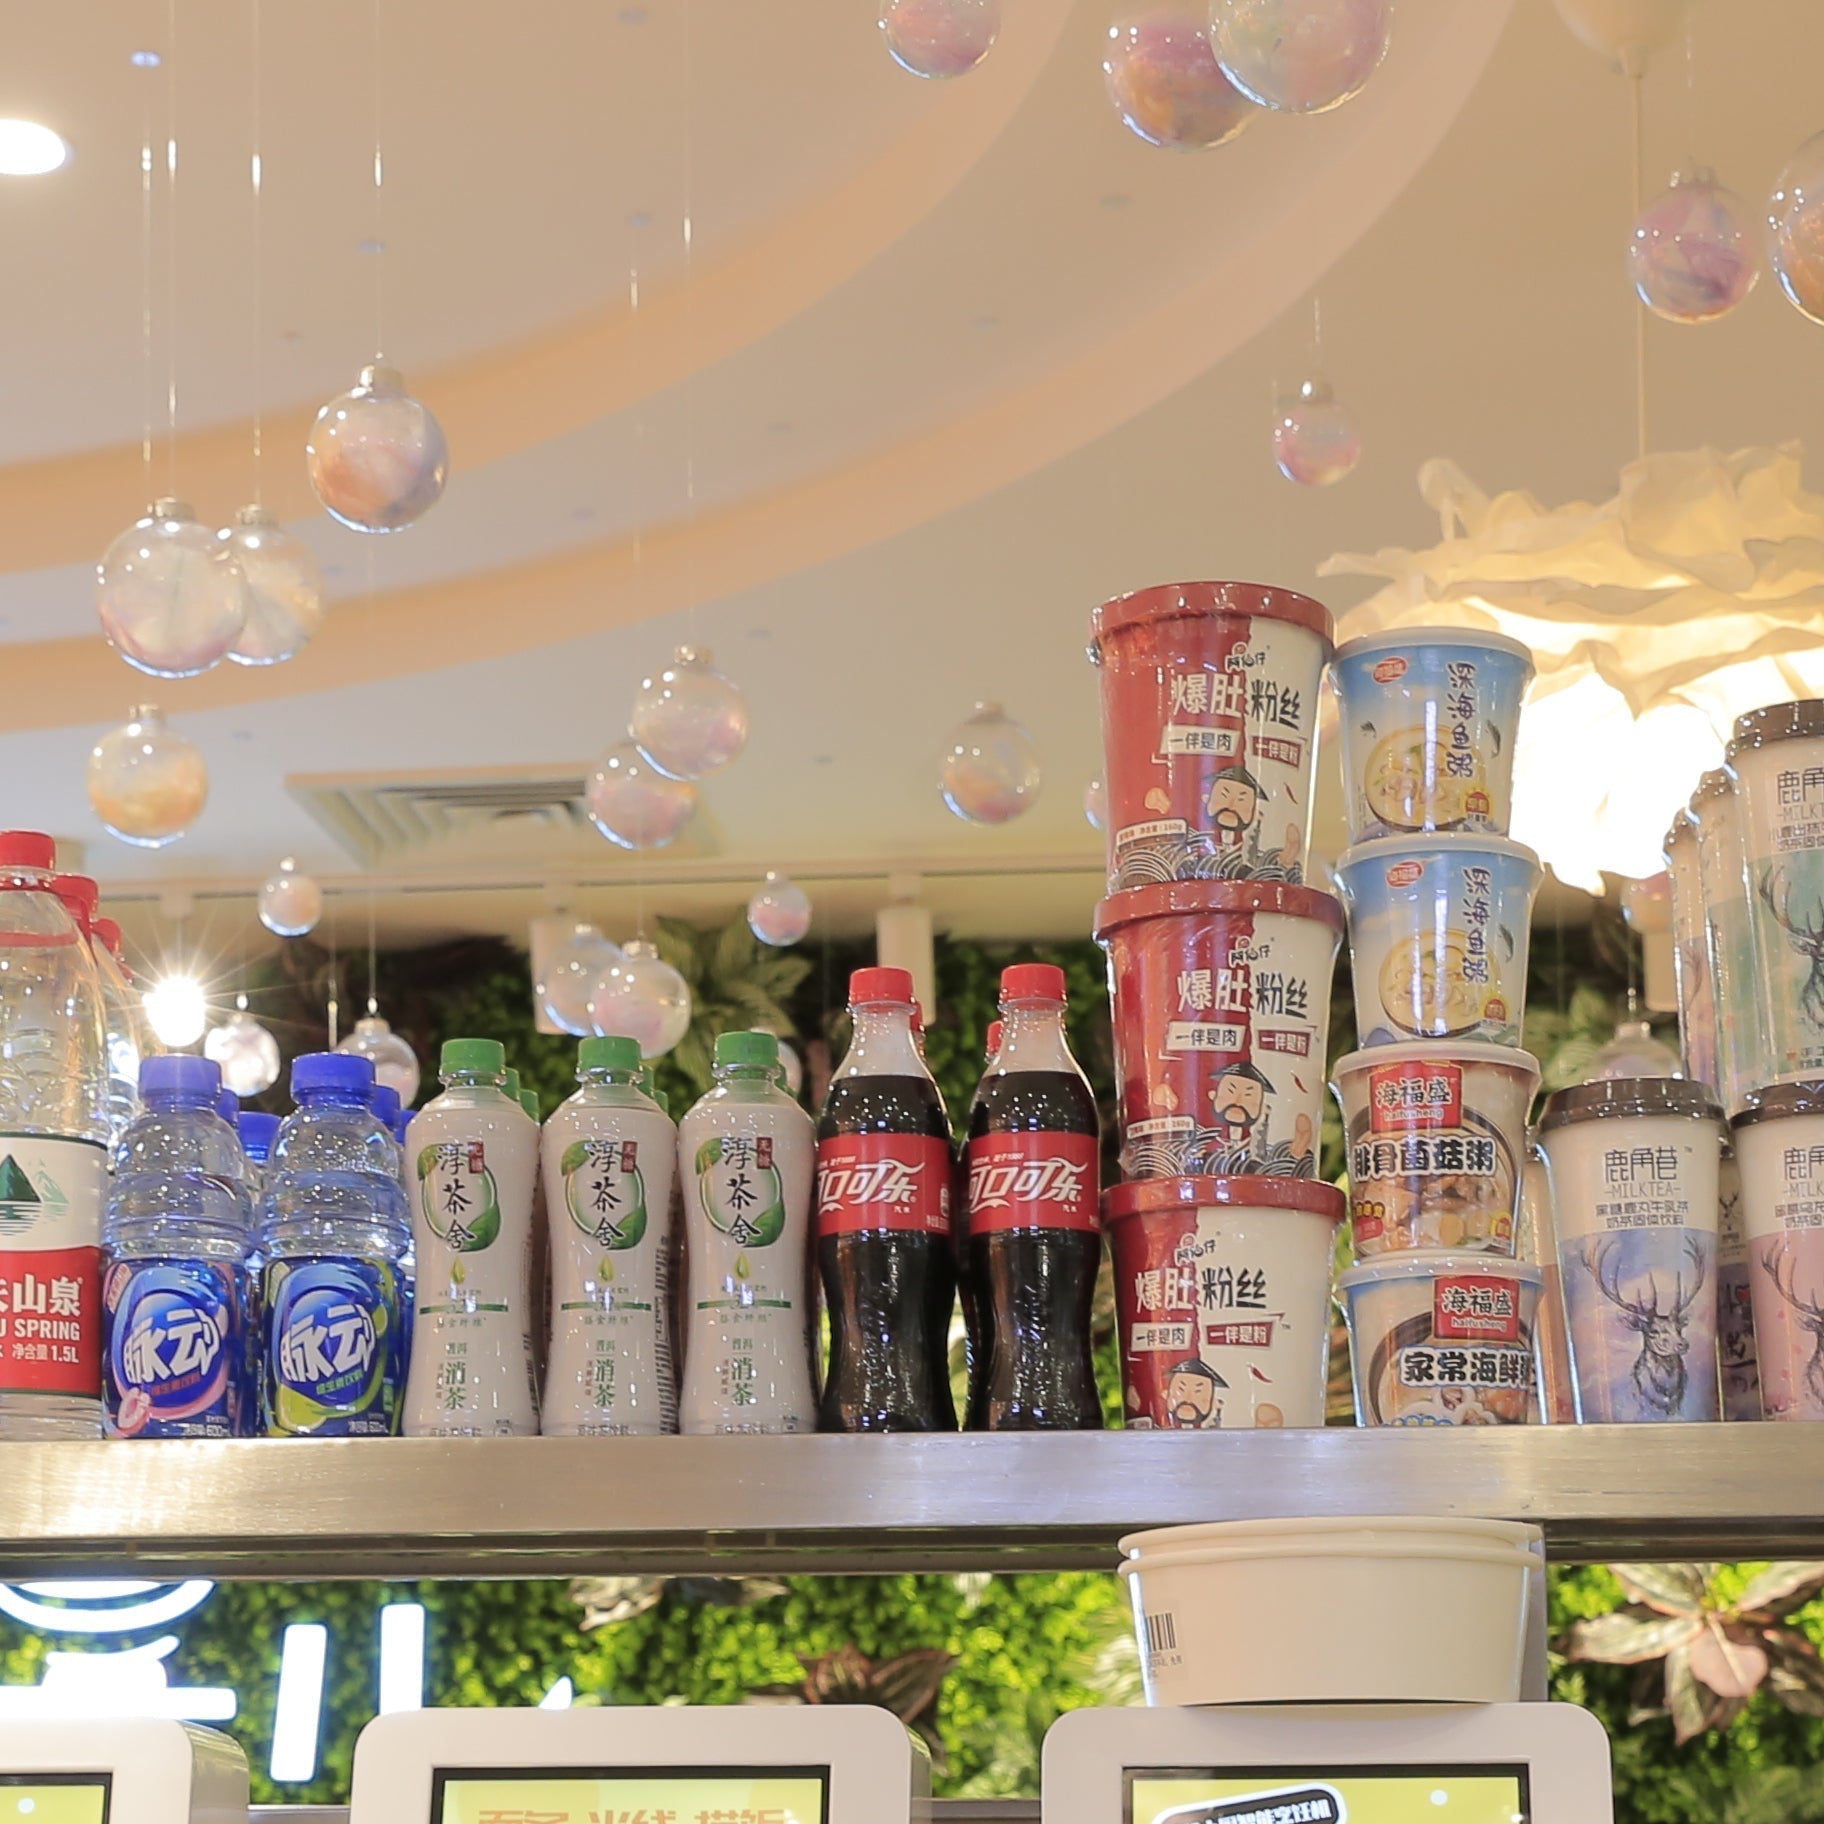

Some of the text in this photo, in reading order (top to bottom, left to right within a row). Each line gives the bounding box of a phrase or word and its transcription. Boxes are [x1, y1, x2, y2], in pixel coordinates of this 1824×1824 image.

[1172, 673, 1300, 730] 爆肚粉丝
[1171, 733, 1231, 750] 一伴是肉
[1177, 968, 1308, 1019] 爆肚粉丝
[1176, 1029, 1236, 1046] 一伴是肉
[1377, 1078, 1451, 1106] 海福盛
[1605, 1146, 1677, 1183] 鹿角巷
[437, 1143, 476, 1250] 淳茶舍
[587, 1140, 624, 1248] 淳茶舍
[722, 1137, 762, 1247] 淳茶舍
[1135, 1267, 1266, 1314] 爆肚粉丝
[1442, 1286, 1512, 1316] 海福盛
[15, 1318, 80, 1340] SPRING
[124, 1308, 220, 1383] 脉动
[280, 1304, 375, 1382] 脉动
[1136, 1328, 1185, 1346] 一伴是肉
